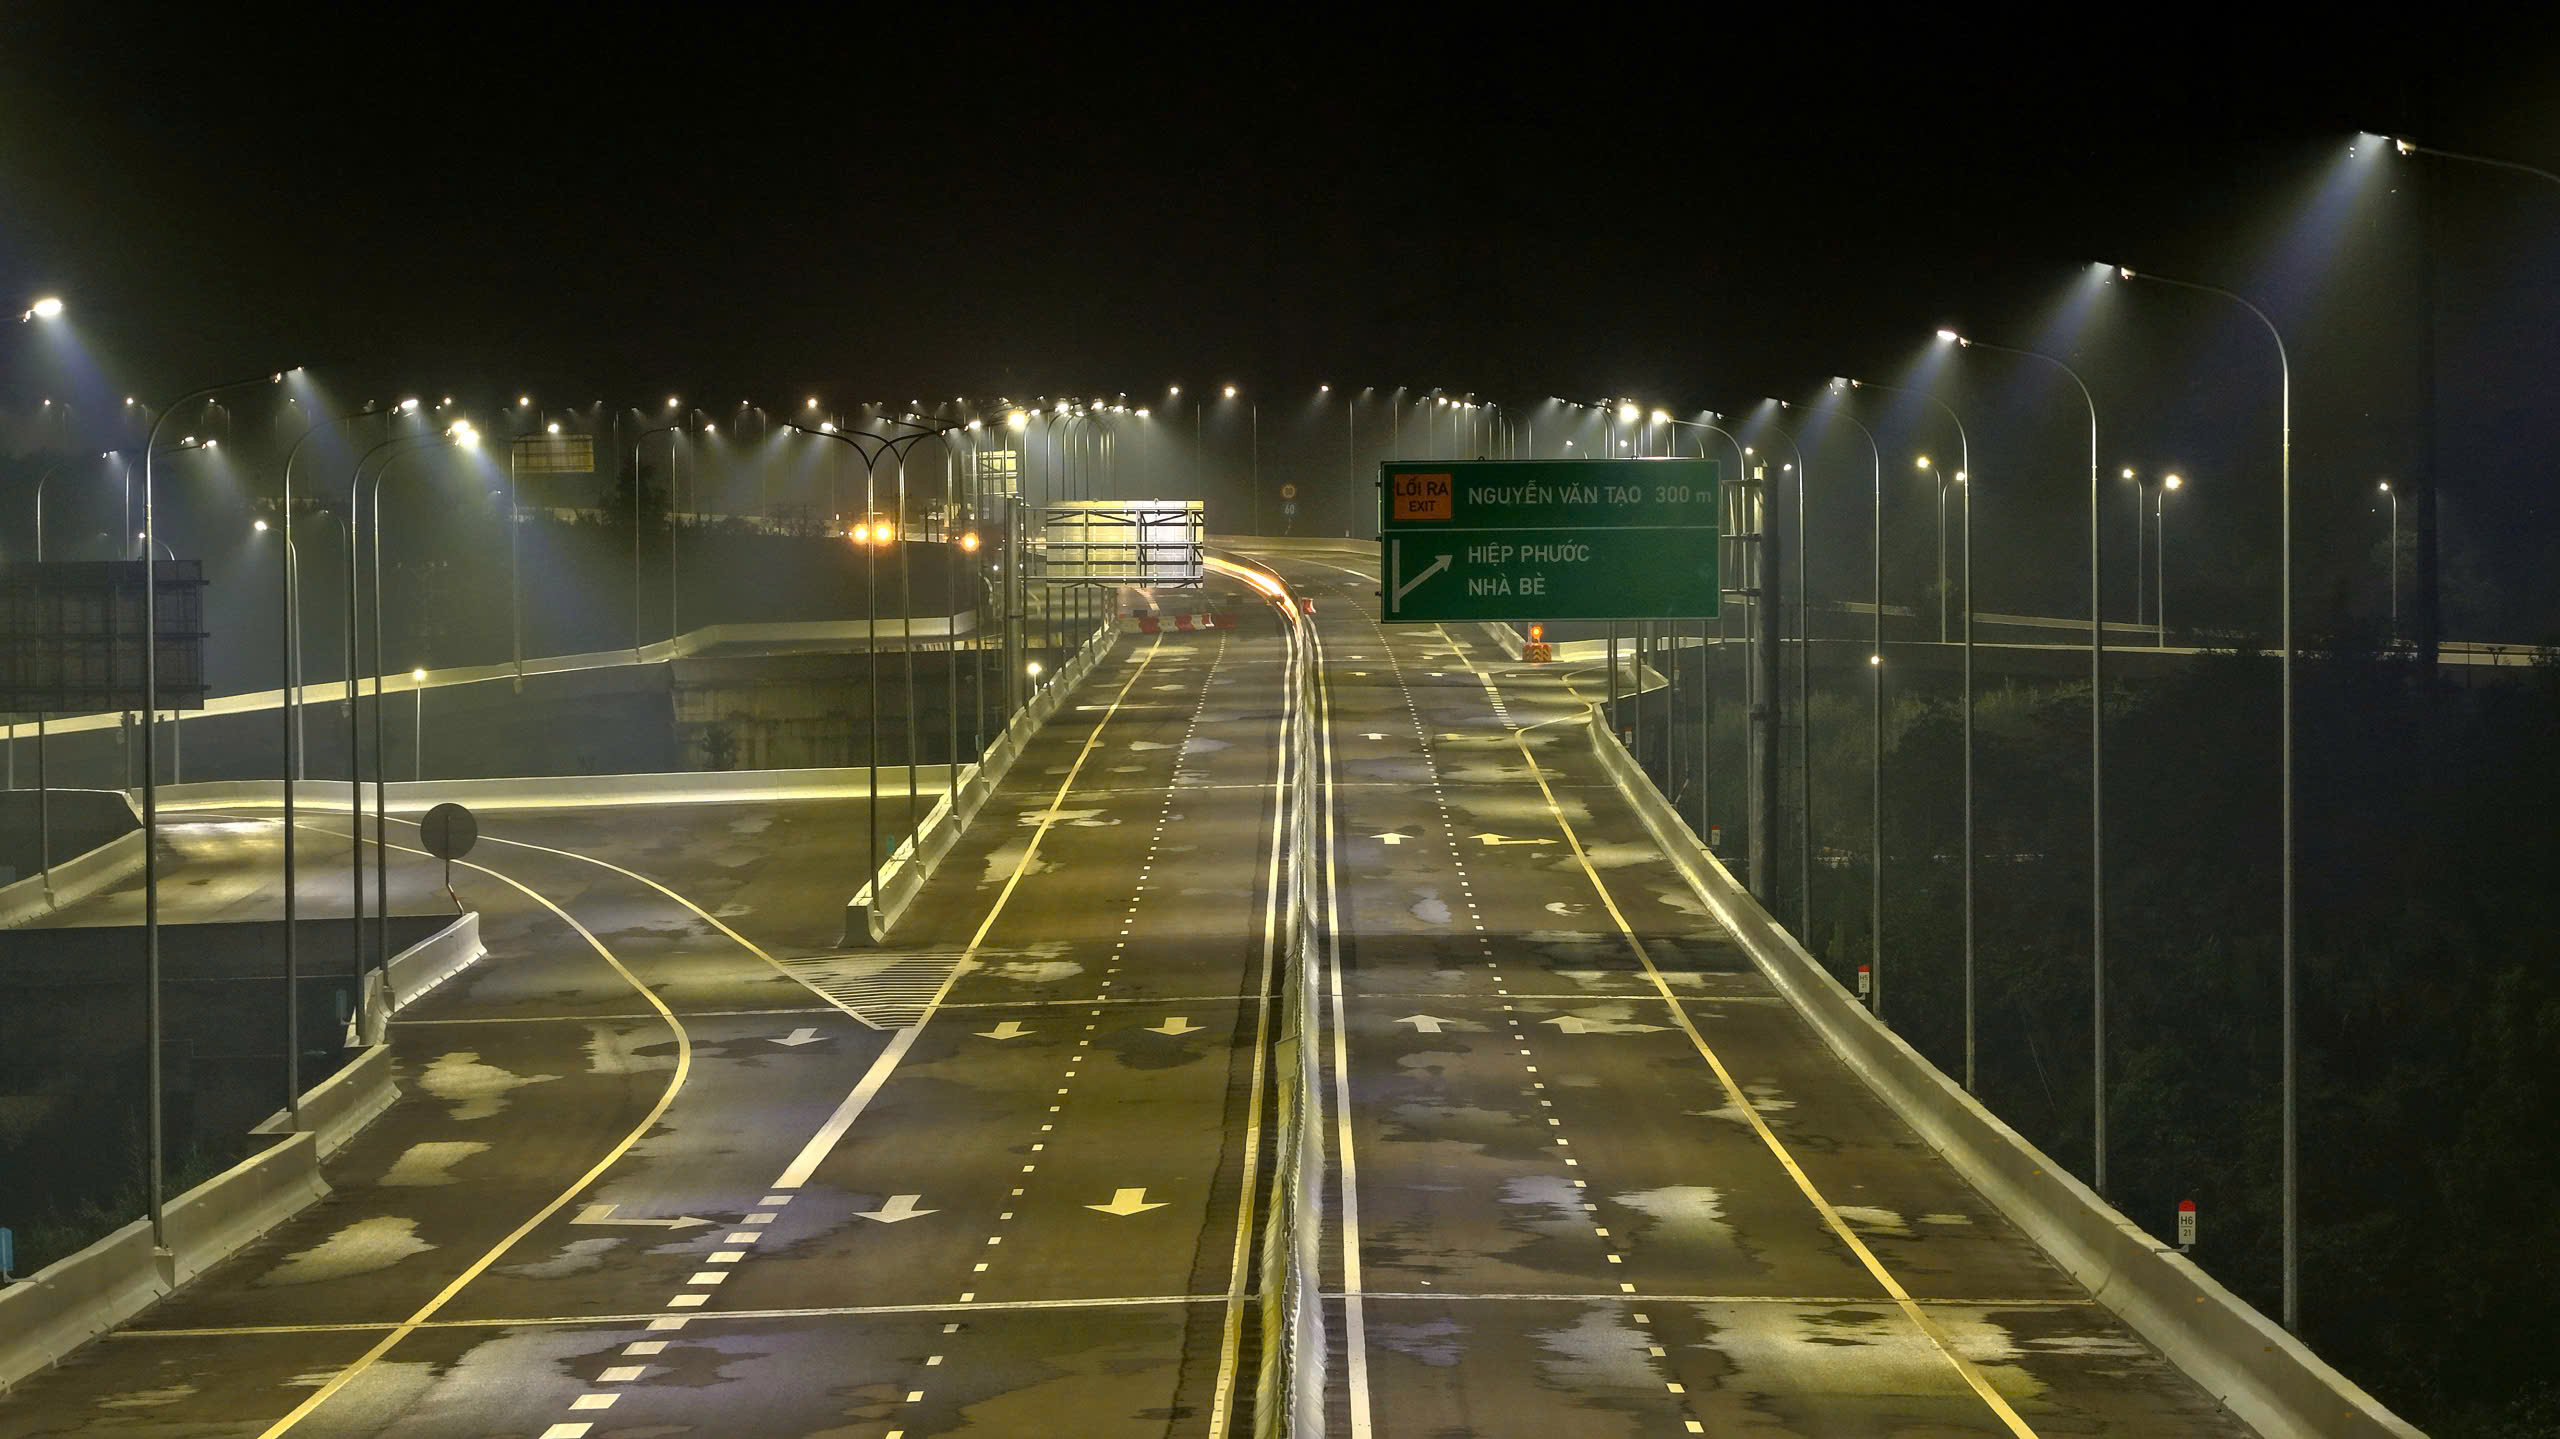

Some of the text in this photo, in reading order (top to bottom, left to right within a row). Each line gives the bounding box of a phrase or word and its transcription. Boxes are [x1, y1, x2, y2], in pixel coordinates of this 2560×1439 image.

[1396, 475, 1449, 497] LỐI RA
[1468, 480, 1712, 507] NGUYỄN VĂN TẠO 300 m
[1409, 501, 1436, 512] EXIT
[1468, 539, 1590, 566] HIỆP PHƯỚC
[1468, 572, 1546, 596] NHÀ BÈ
[2181, 1216, 2193, 1225] H6
[2183, 1229, 2191, 1237] 21
